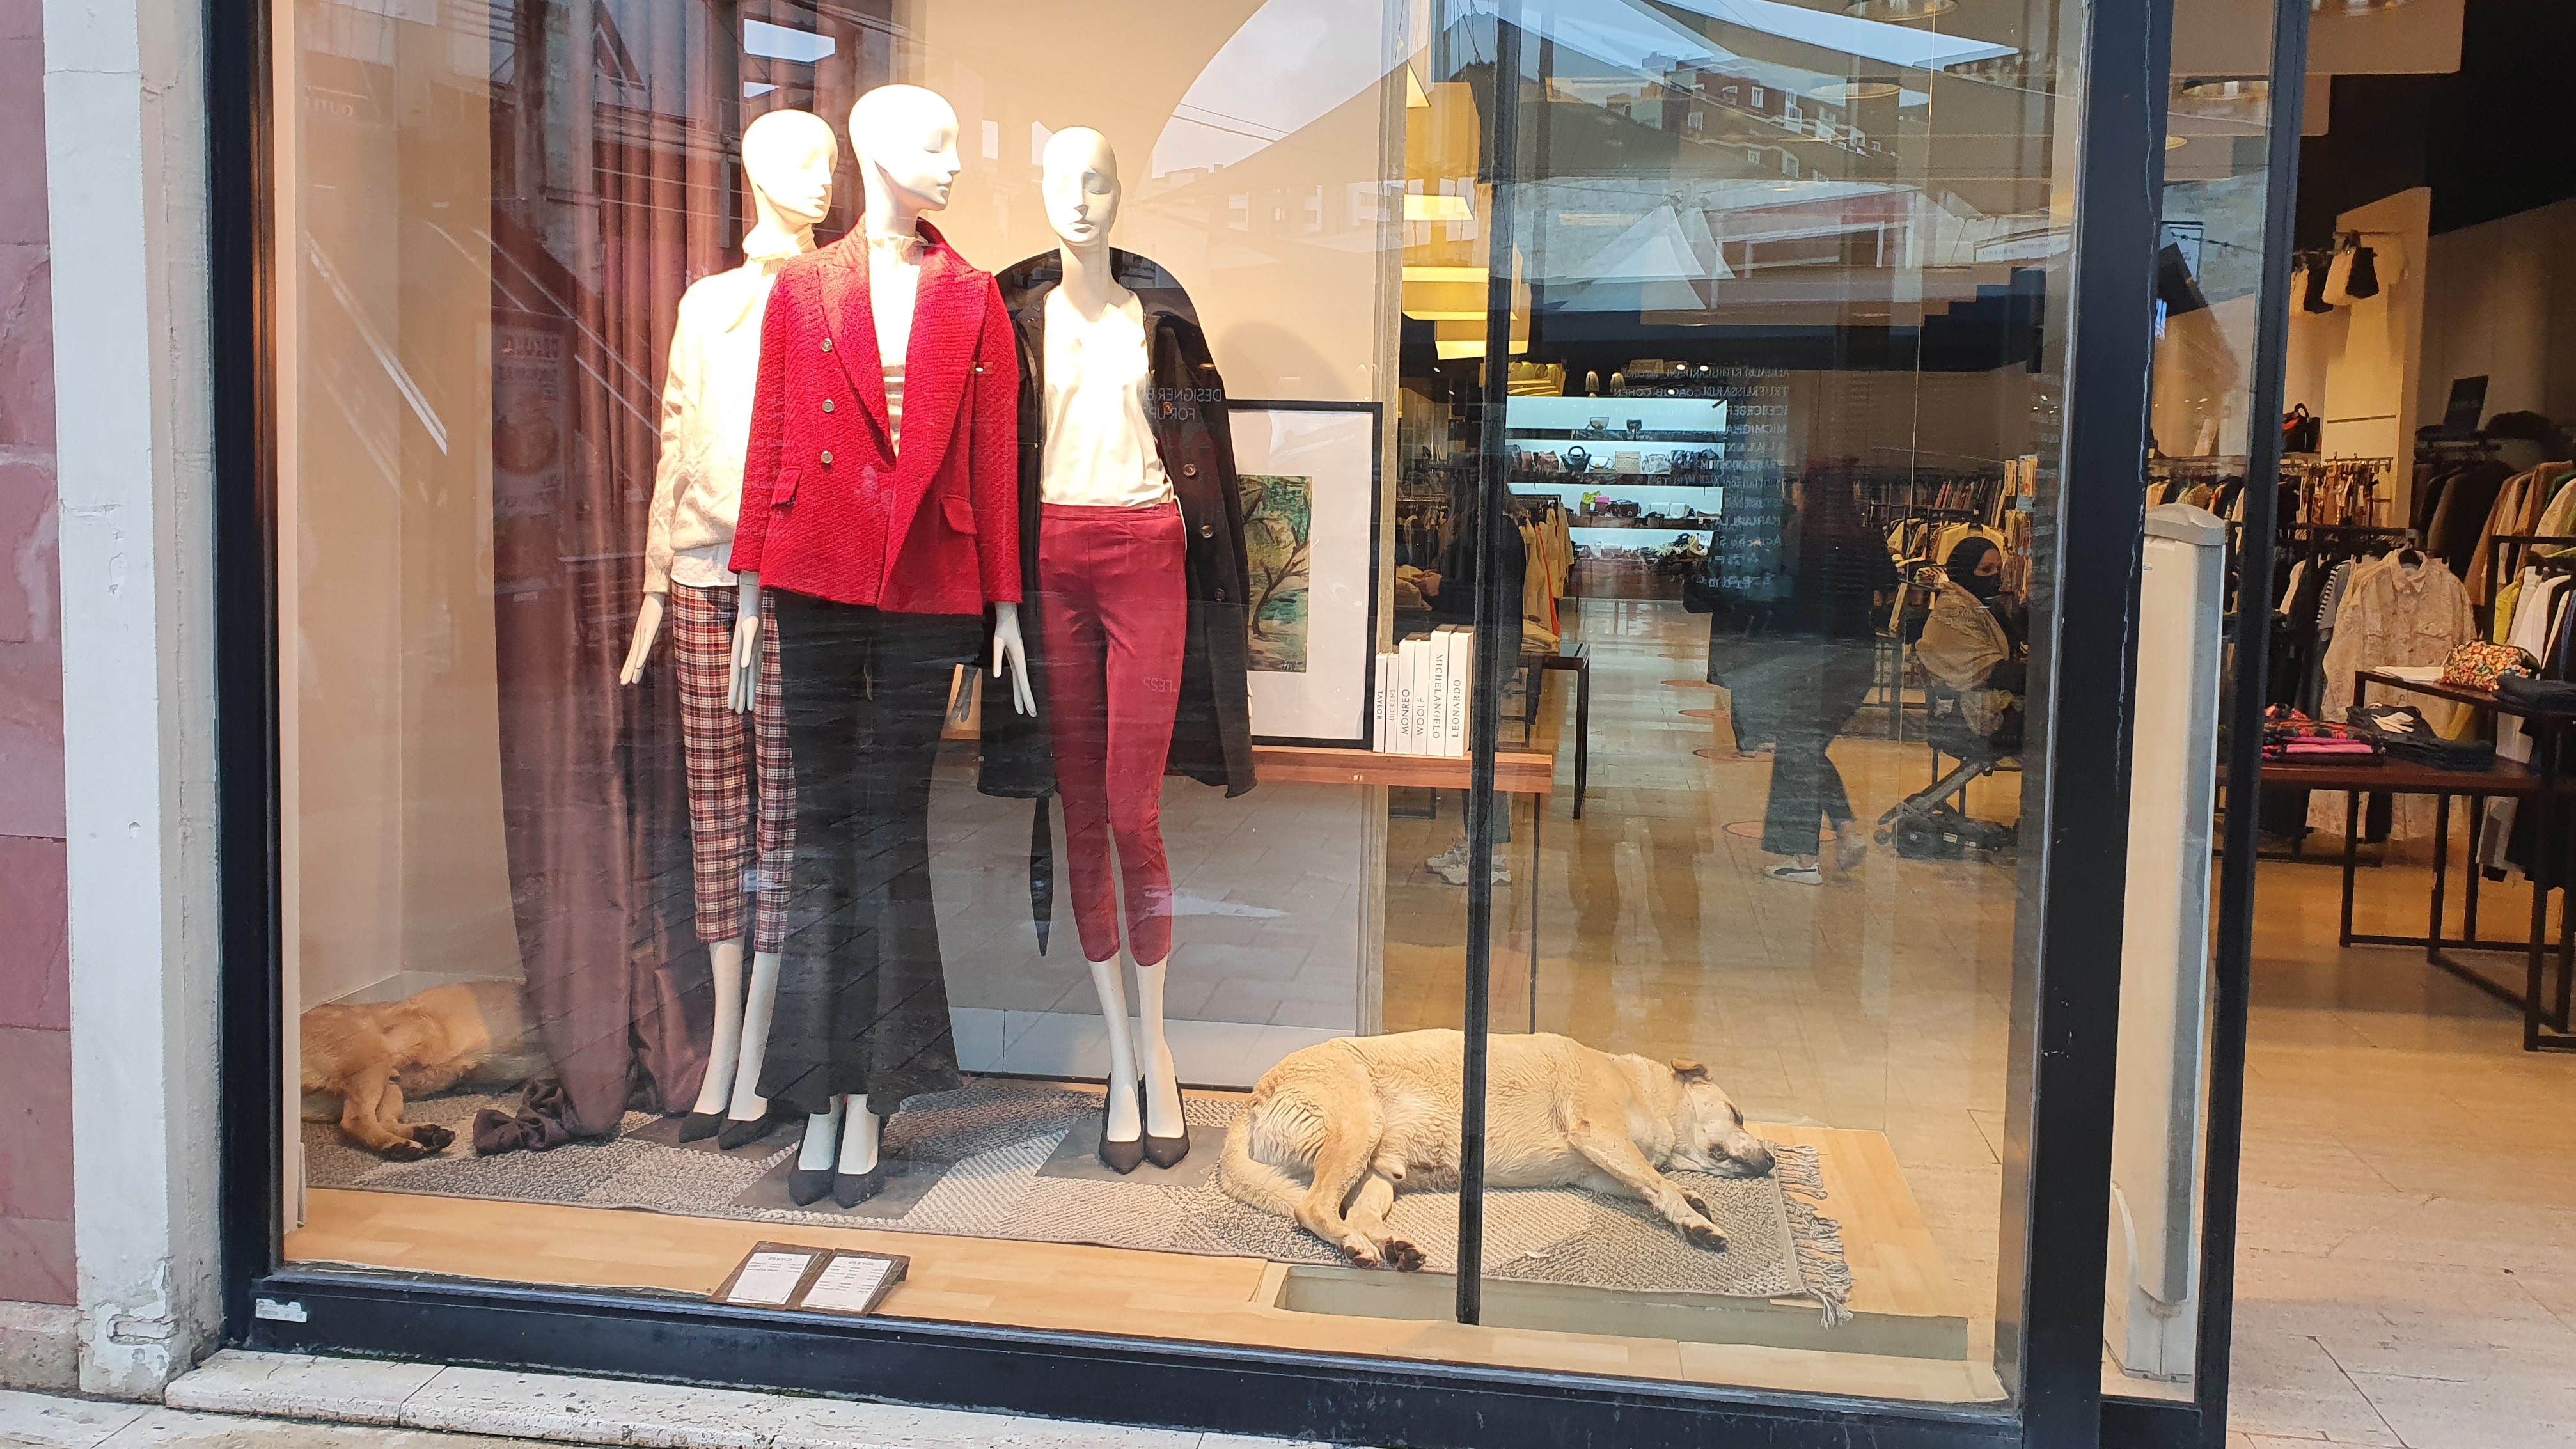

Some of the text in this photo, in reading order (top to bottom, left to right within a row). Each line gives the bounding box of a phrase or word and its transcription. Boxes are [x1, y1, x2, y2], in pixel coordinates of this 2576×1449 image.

[1401, 689, 1410, 735] MONREO
[1417, 698, 1425, 735] WOOLF
[1433, 654, 1443, 739] MICHELANGELO
[1452, 679, 1461, 738] LEONARDO
